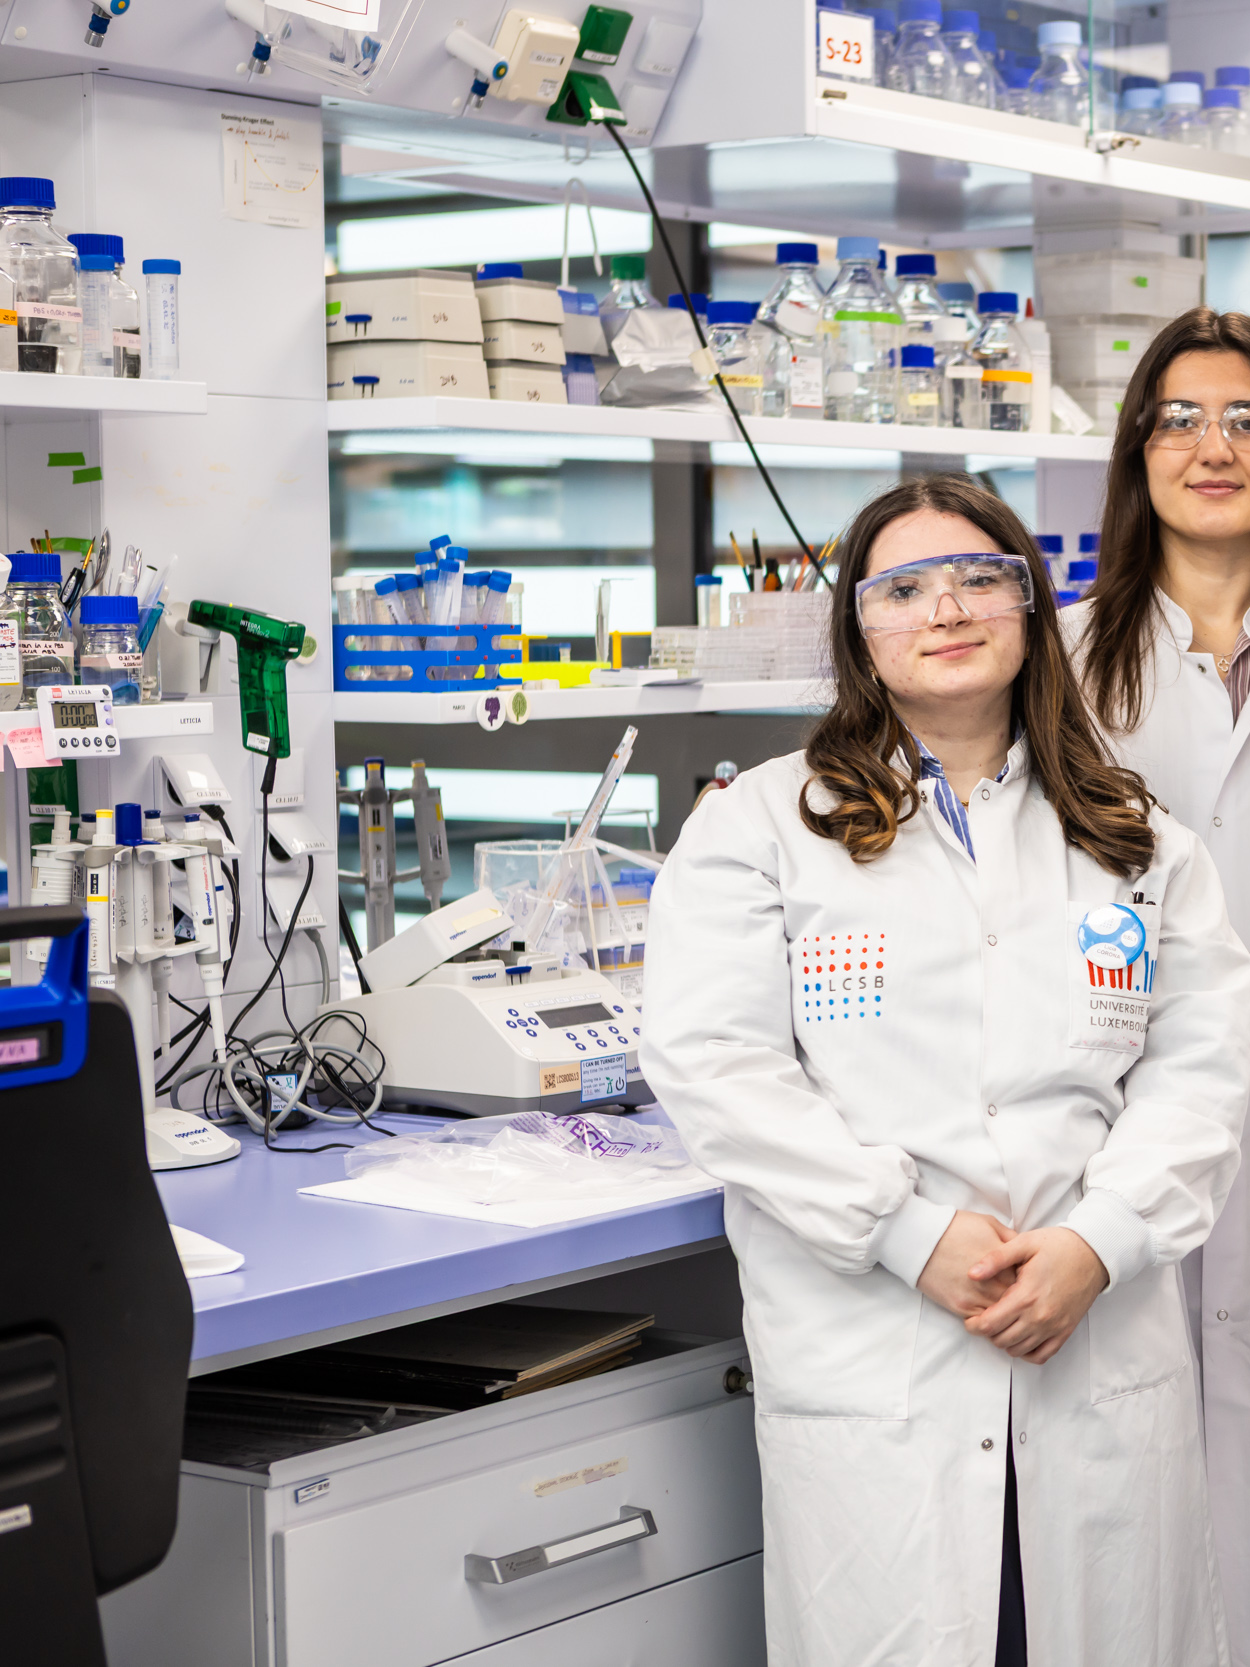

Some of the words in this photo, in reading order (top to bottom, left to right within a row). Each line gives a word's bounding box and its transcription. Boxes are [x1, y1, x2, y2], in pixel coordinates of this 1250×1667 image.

[826, 37, 862, 64] S-23
[205, 893, 213, 916] eppendorf
[1096, 949, 1121, 959] CORONA
[472, 972, 497, 982] eppendorf
[829, 975, 884, 992] LCSB
[1090, 1000, 1145, 1017] UNIVERSITÉ
[1090, 1016, 1149, 1033] LUXEMBOU
[600, 1057, 616, 1065] TURNED
[556, 1071, 580, 1084] LCSB00513
[174, 1127, 209, 1138] eppendorf
